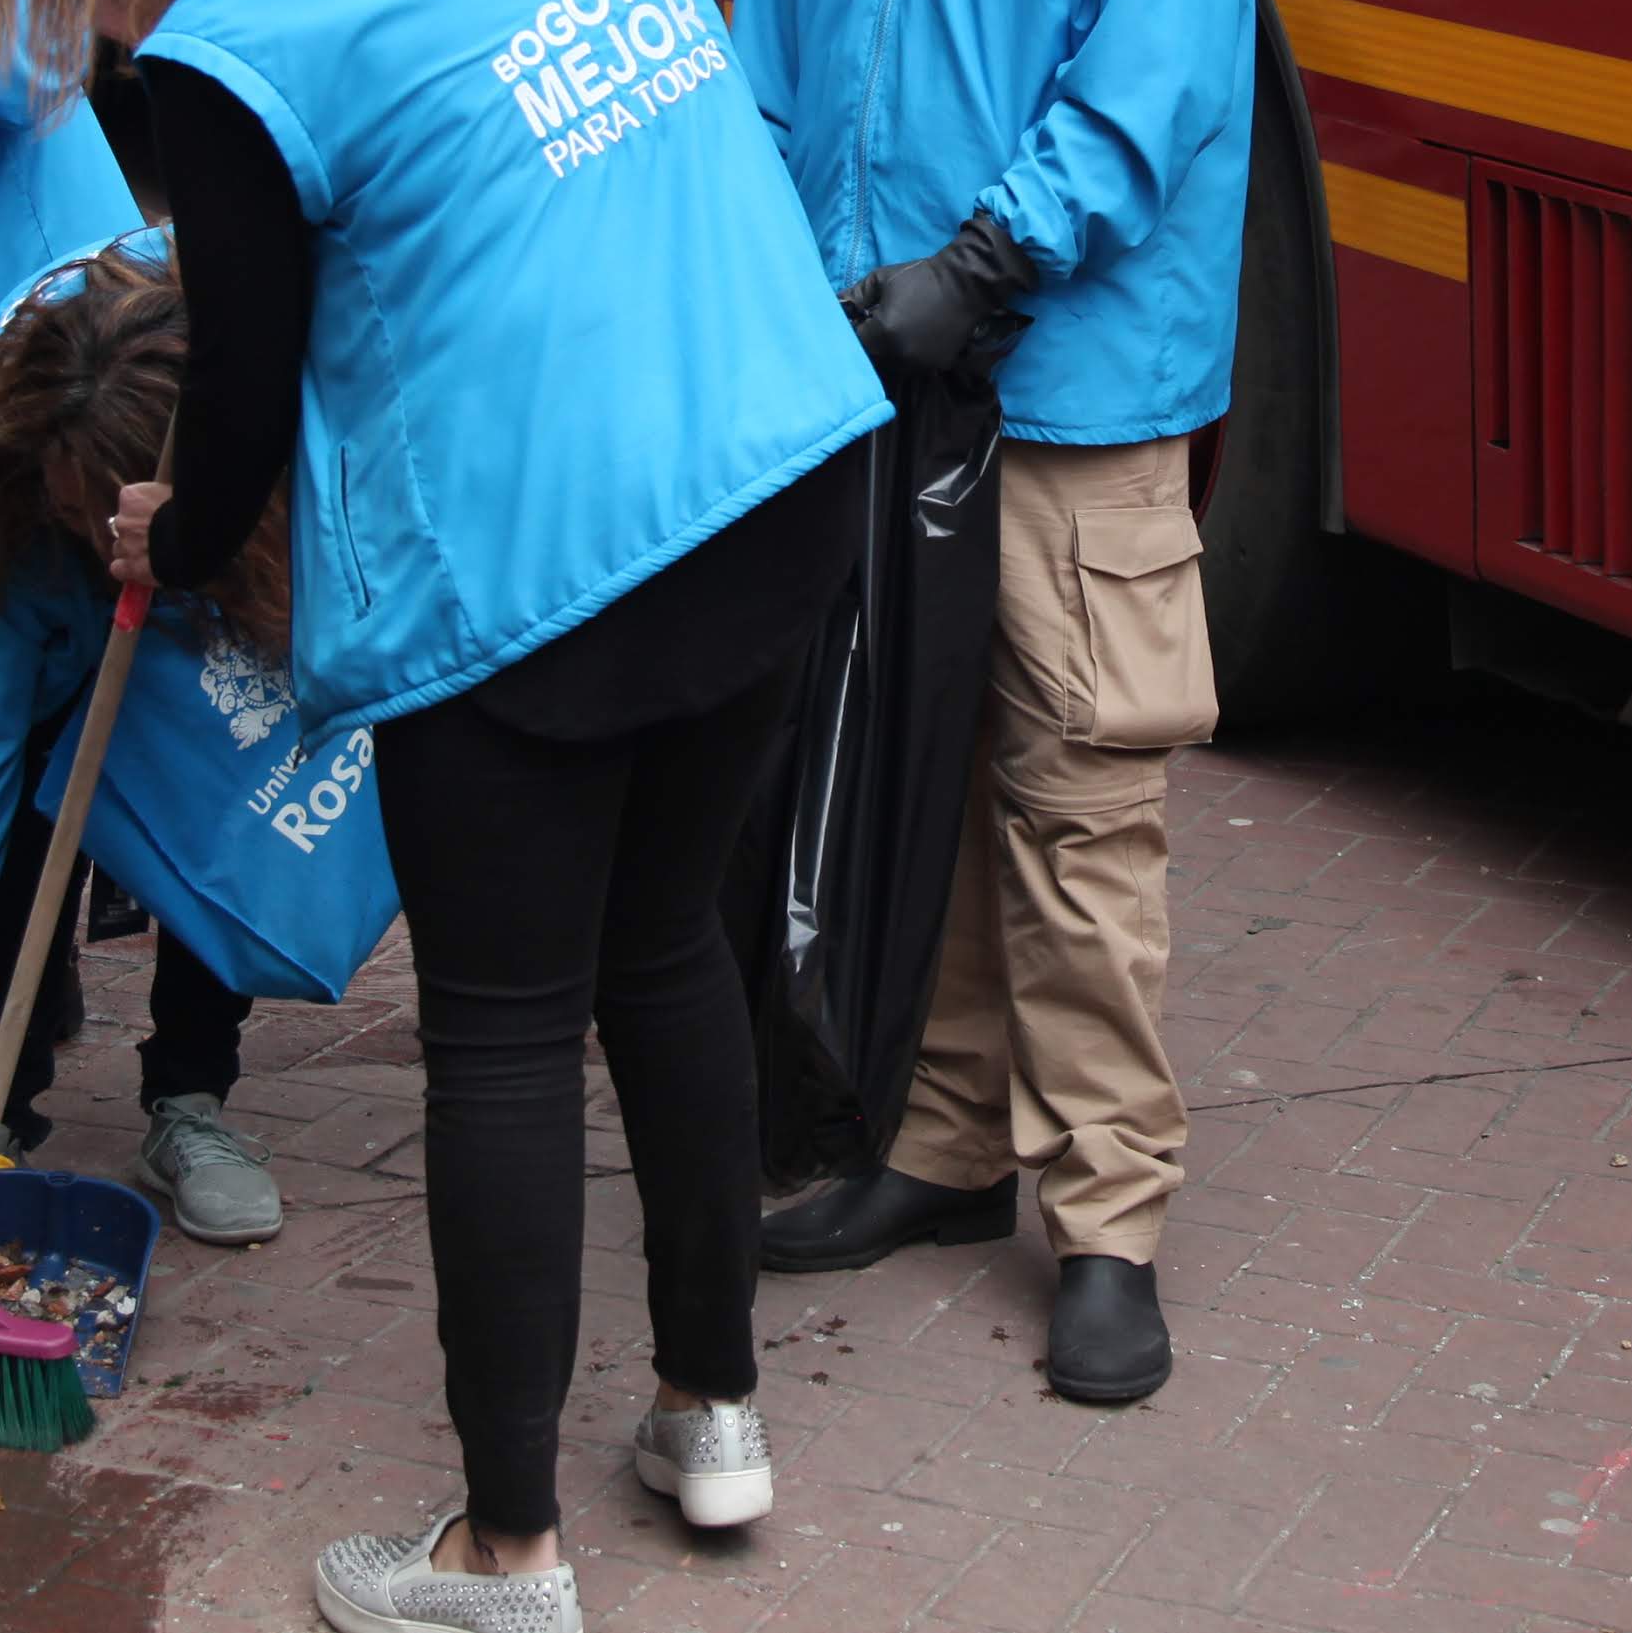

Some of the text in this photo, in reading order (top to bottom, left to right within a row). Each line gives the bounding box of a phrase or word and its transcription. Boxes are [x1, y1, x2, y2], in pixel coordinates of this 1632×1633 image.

[542, 38, 728, 179] PARA TODOS
[270, 724, 375, 854] Rosa
